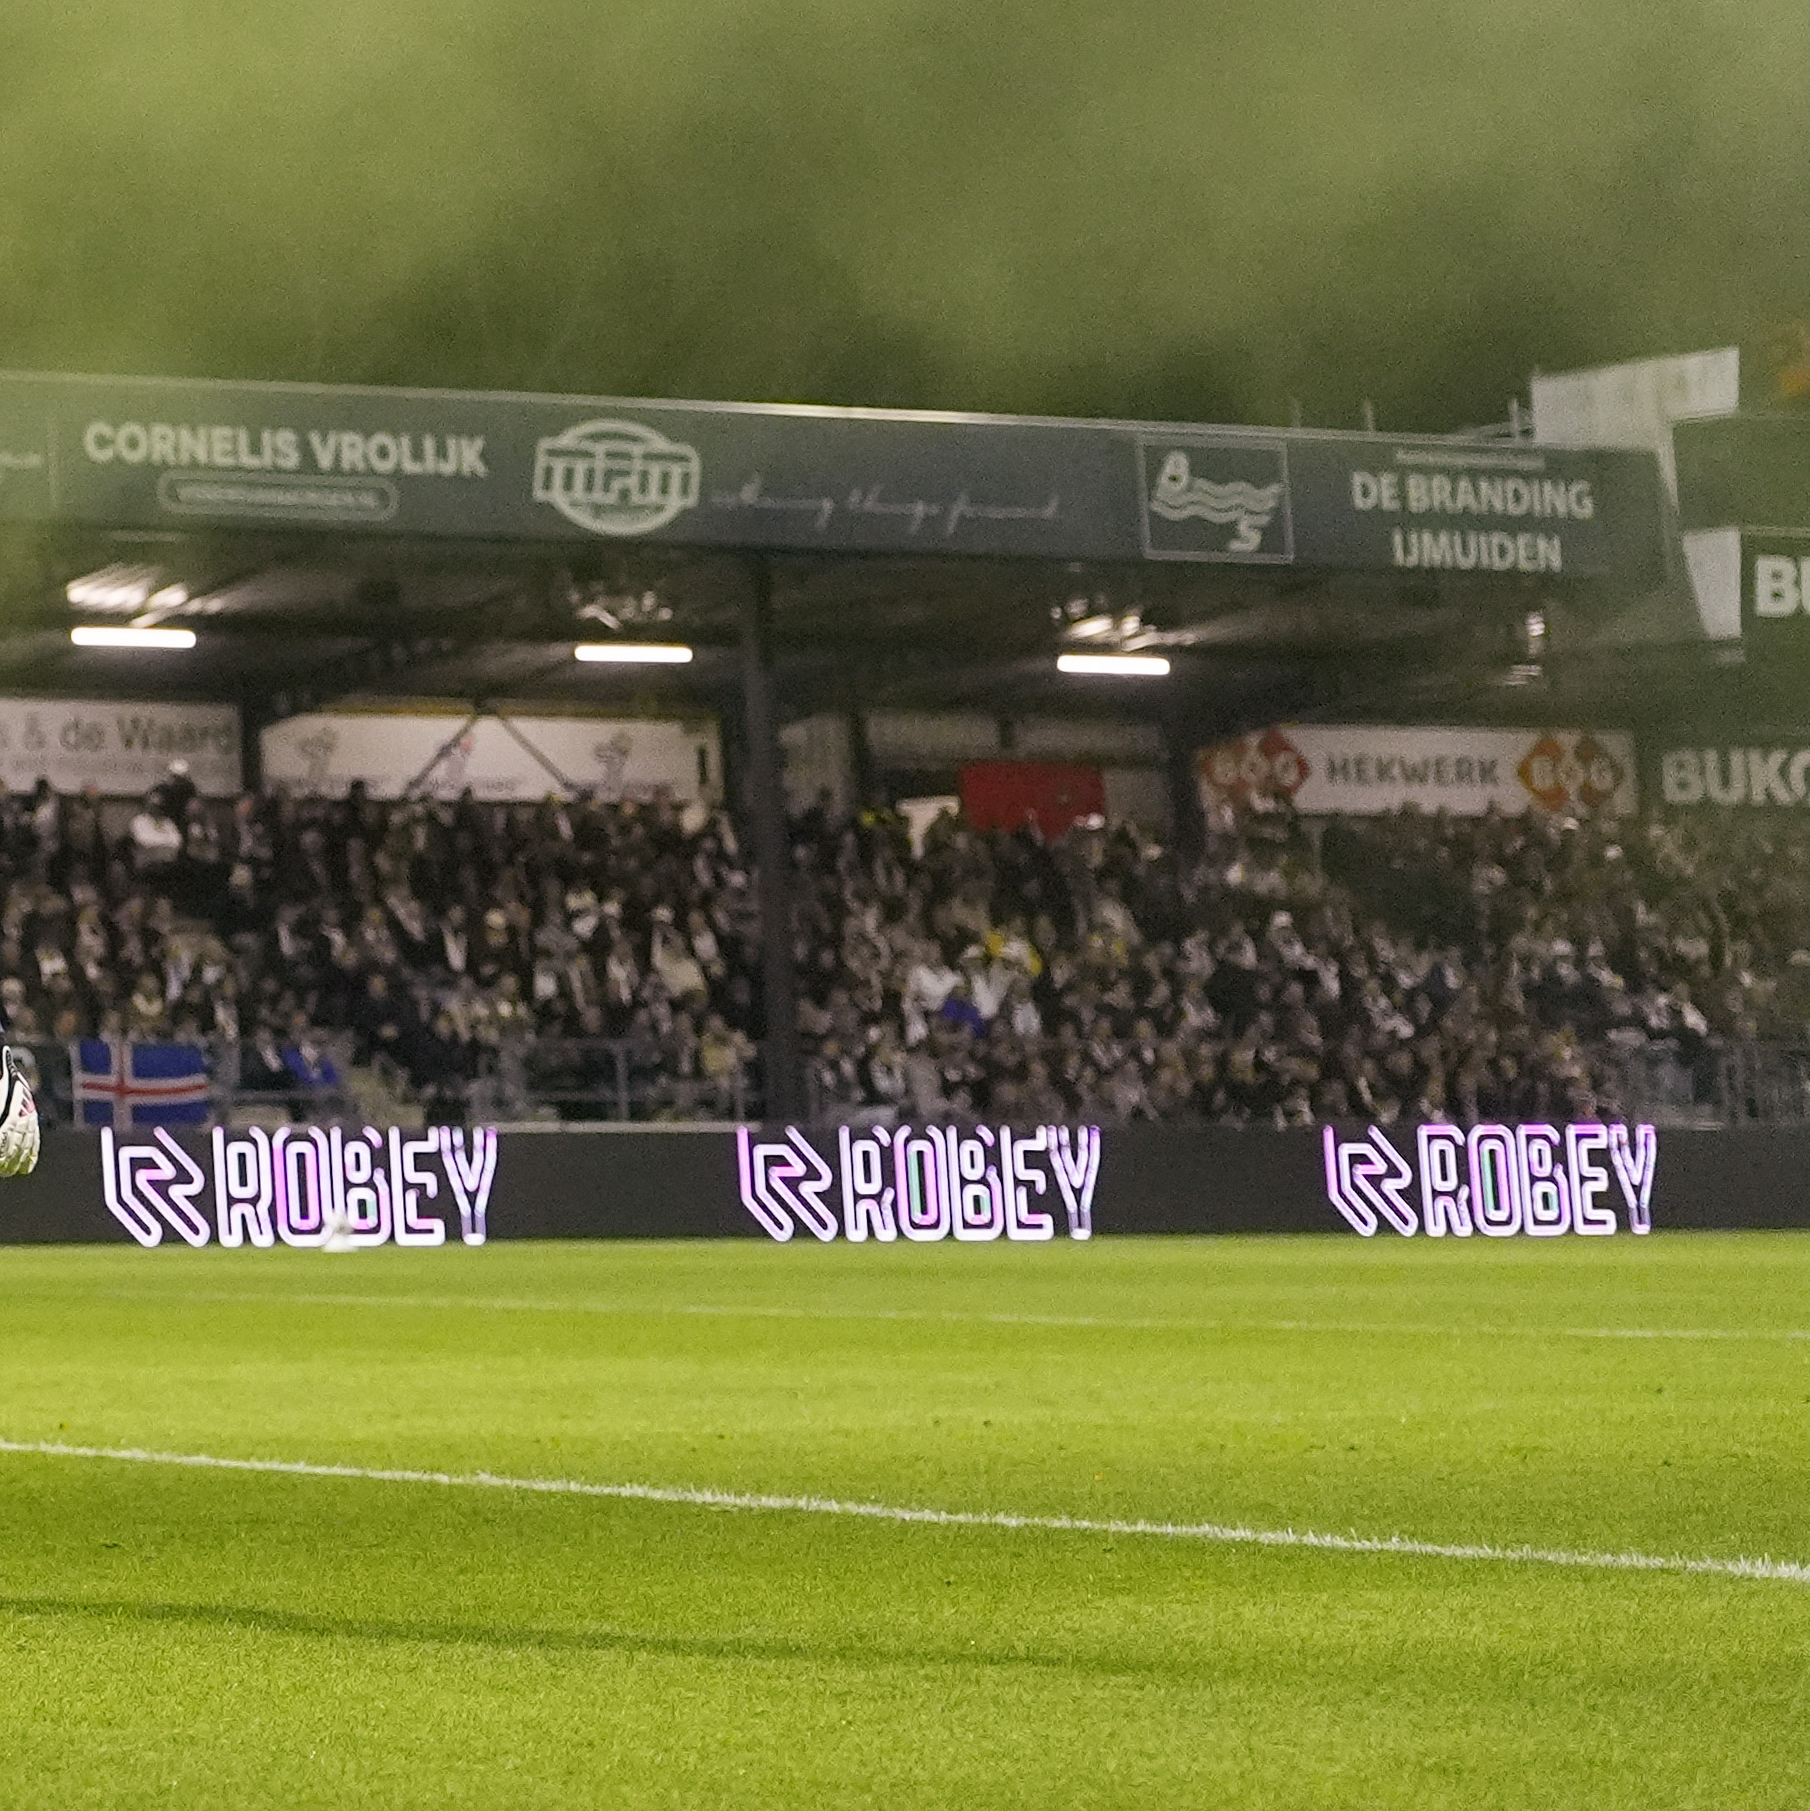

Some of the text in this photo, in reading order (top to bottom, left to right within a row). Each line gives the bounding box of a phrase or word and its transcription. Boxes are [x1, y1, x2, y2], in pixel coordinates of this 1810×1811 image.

[83, 421, 301, 470] CORNELIS
[308, 429, 489, 477] VROLIJK
[1351, 471, 1595, 519] DE BRANDING
[1392, 527, 1563, 573] IJMUIDEN
[1755, 554, 1810, 619] B
[1326, 756, 1499, 788] HEKWERK
[212, 1125, 497, 1248] ROBEY
[839, 1124, 1101, 1242] ROBEY
[1419, 1123, 1656, 1235] ROBEY
